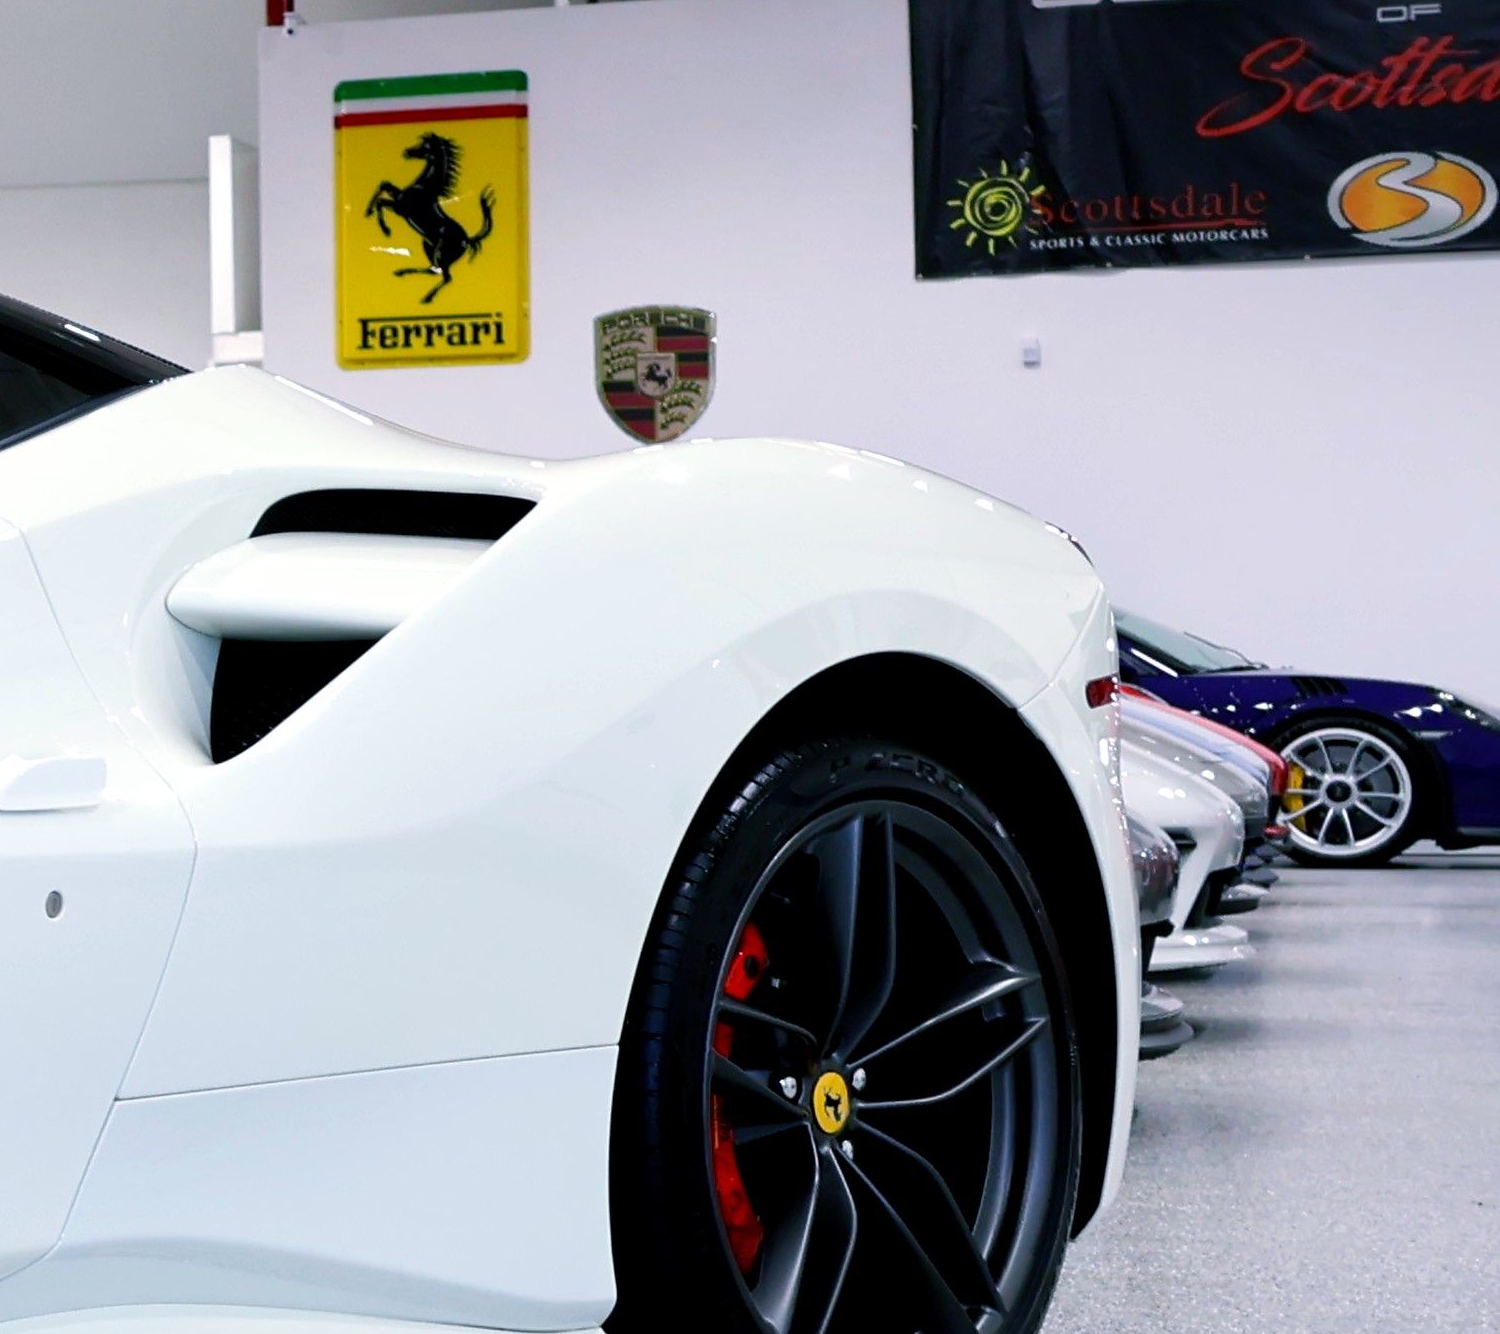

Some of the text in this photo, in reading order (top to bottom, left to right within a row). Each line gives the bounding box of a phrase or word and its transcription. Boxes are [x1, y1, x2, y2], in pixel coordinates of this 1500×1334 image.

[1376, 3, 1442, 23] OF
[1030, 181, 1269, 223] Scottsdale
[1029, 227, 1269, 250] SPORTS & CLASSIC MOTORCARS
[358, 312, 505, 350] Ferrari
